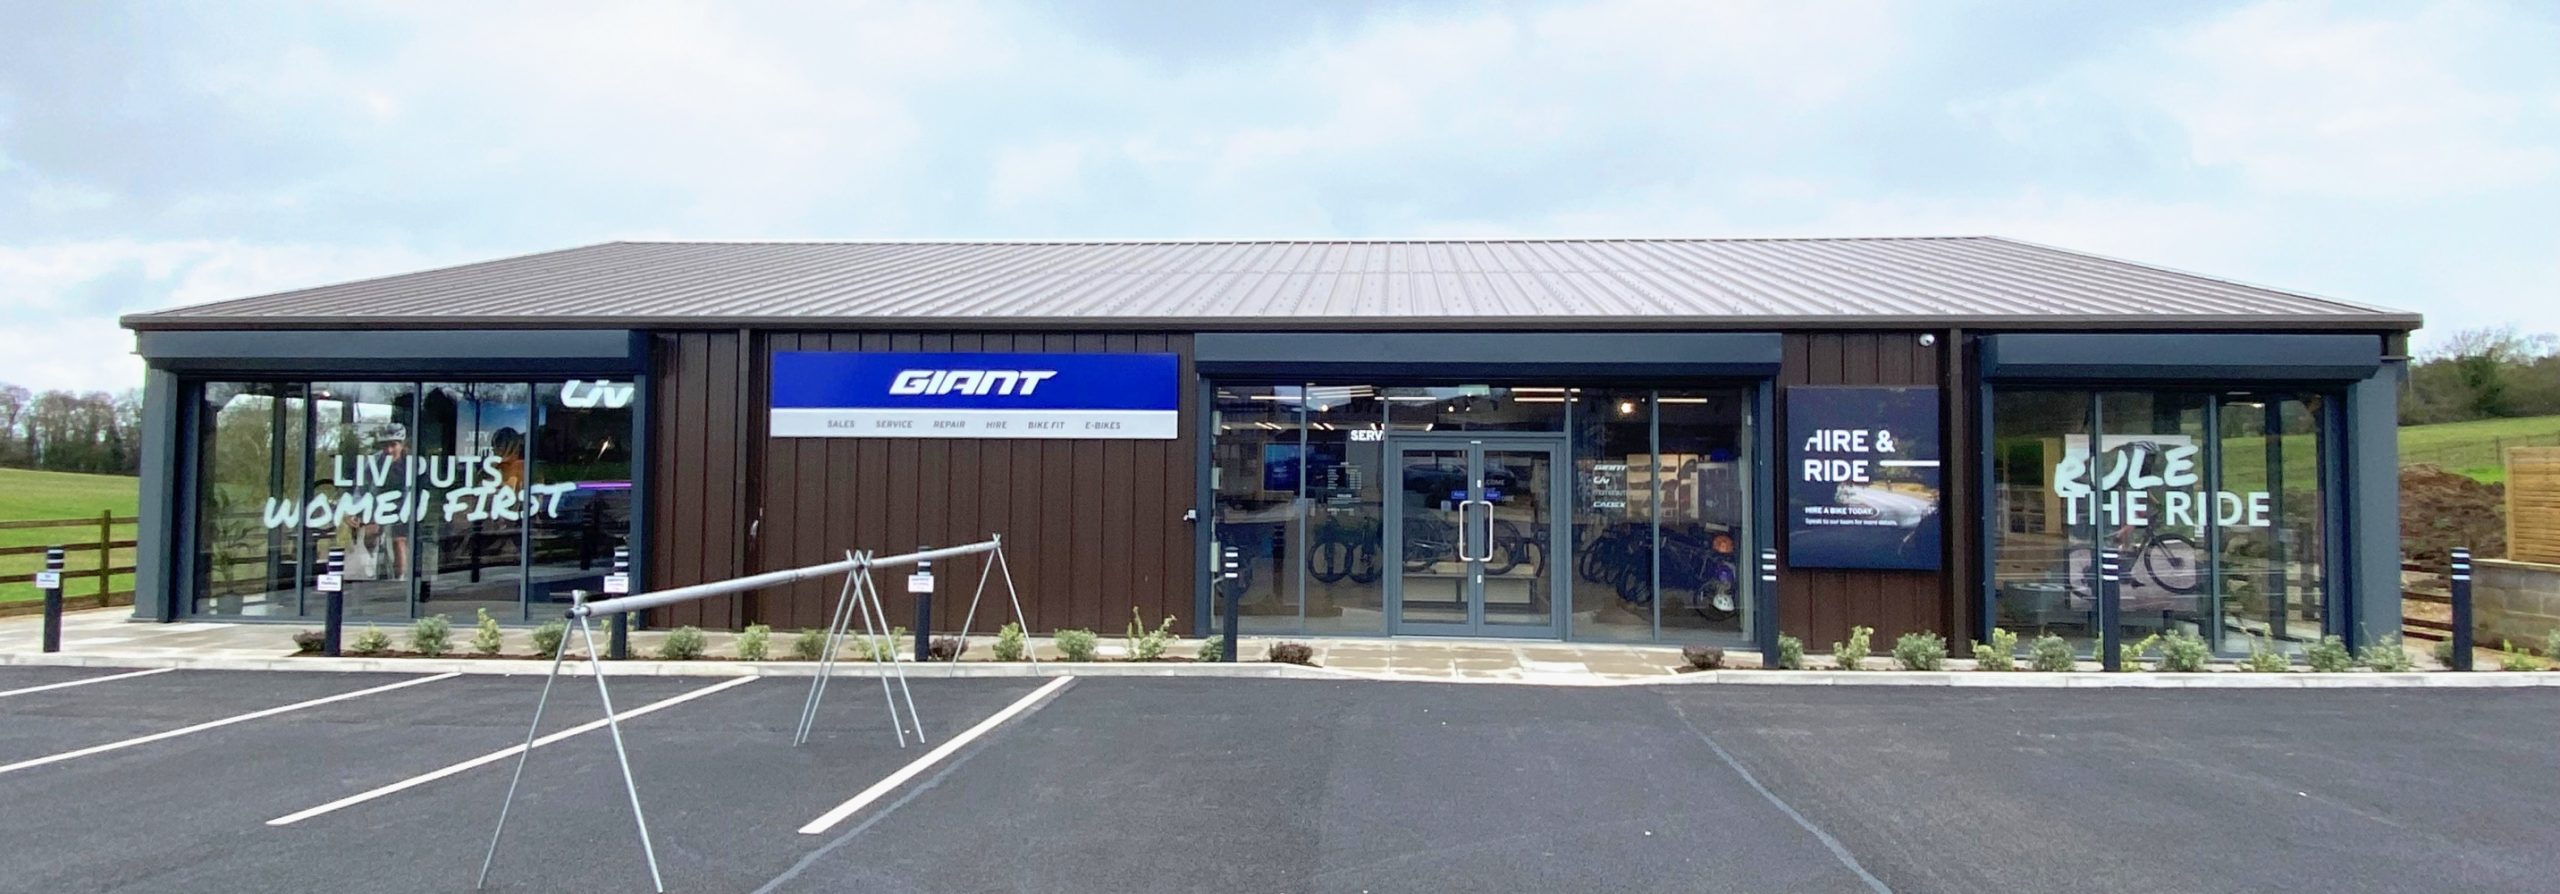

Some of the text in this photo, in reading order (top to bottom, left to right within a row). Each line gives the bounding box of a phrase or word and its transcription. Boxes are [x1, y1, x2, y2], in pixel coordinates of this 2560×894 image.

[889, 370, 1057, 395] GIANT
[827, 420, 855, 428] SALES
[875, 420, 913, 428] SERVICE
[933, 420, 966, 428] REPAIR
[986, 421, 1008, 429] HIRE
[1028, 421, 1065, 429] BIKE FIT
[1085, 422, 1121, 430] E-BIKES
[1350, 429, 1384, 441] SERV
[1805, 429, 1896, 452] HIRE &
[333, 455, 503, 488] LIV PUTS
[1804, 459, 1870, 482] RIDE
[2054, 444, 2199, 497] RULE
[263, 482, 577, 529] WOMEN FIRST
[2061, 490, 2271, 527] THE RIDE
